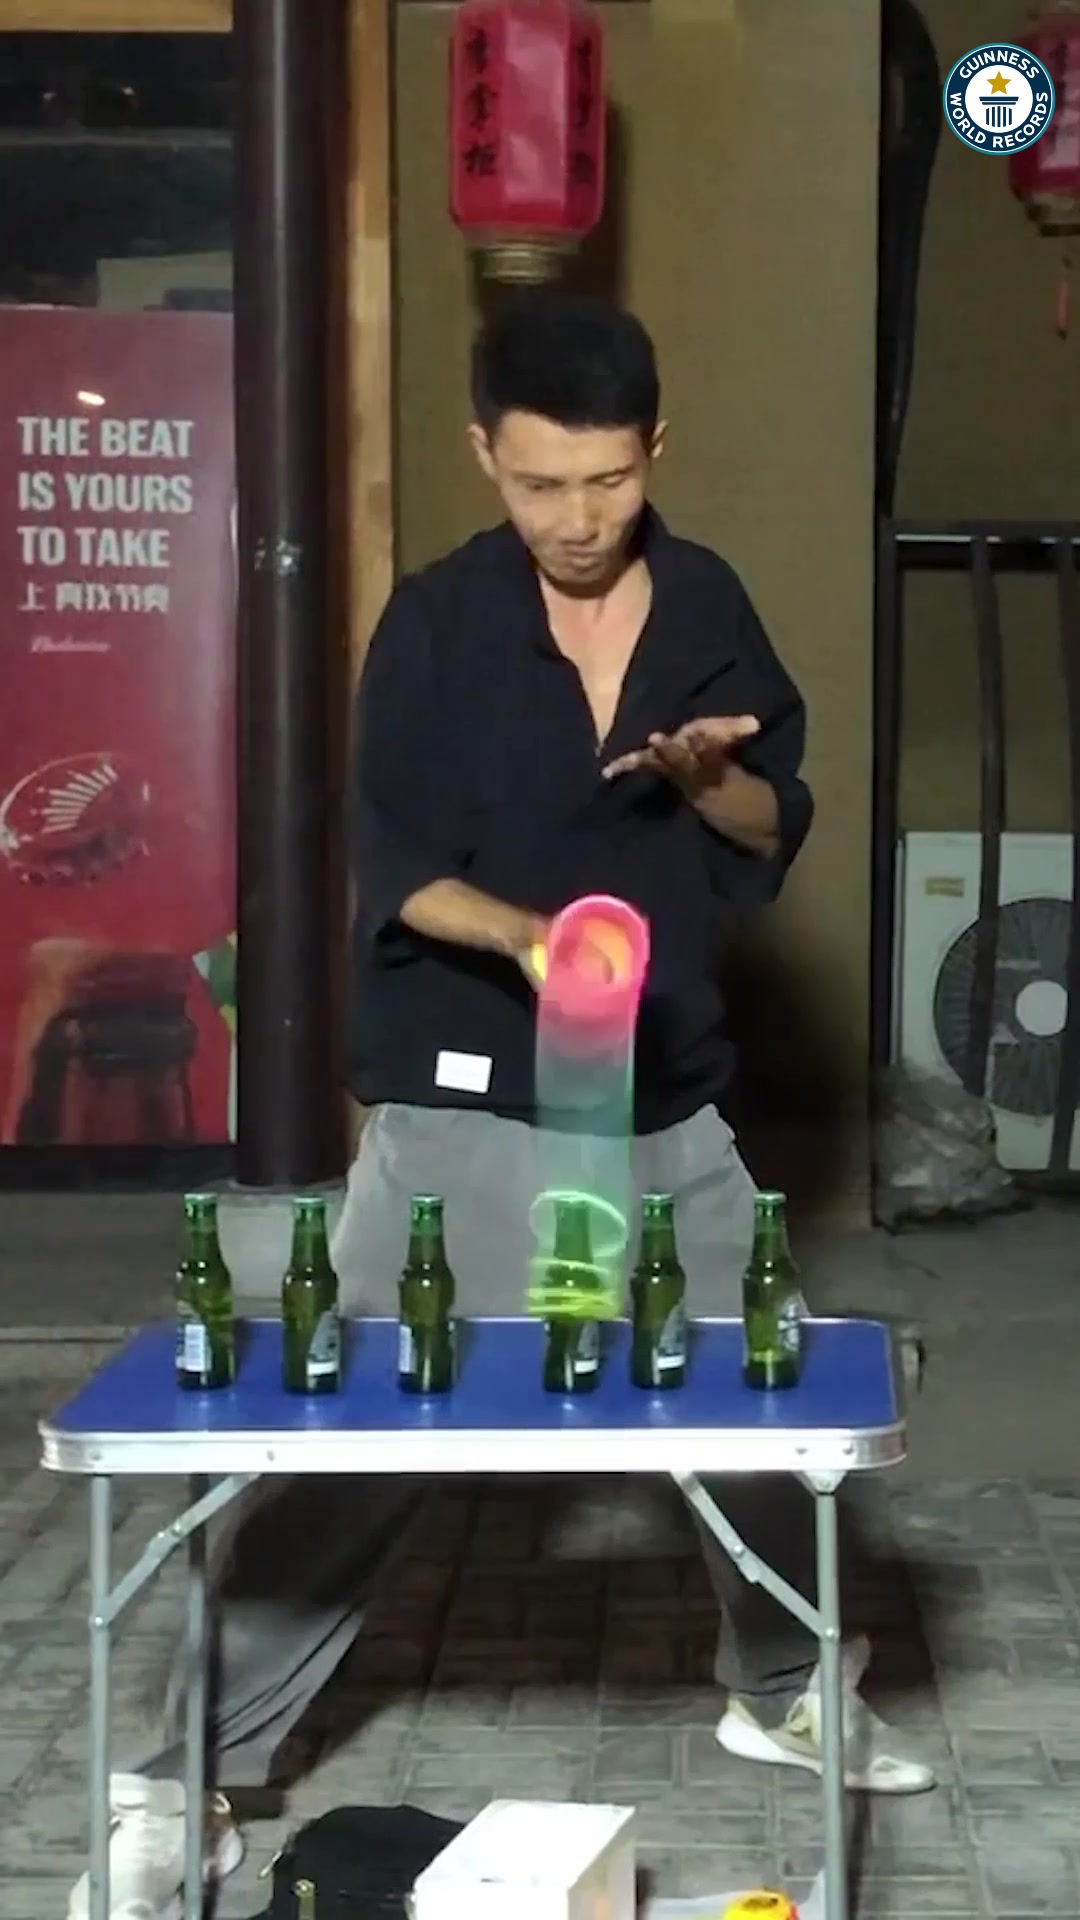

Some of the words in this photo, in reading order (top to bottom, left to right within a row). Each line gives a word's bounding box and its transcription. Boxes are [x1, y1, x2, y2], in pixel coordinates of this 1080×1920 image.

[17, 416, 89, 456] THE
[101, 419, 195, 458] BEAT
[18, 471, 55, 511] IS
[64, 472, 193, 514] YOURS
[17, 525, 65, 566] TO
[75, 527, 170, 568] TAKE
